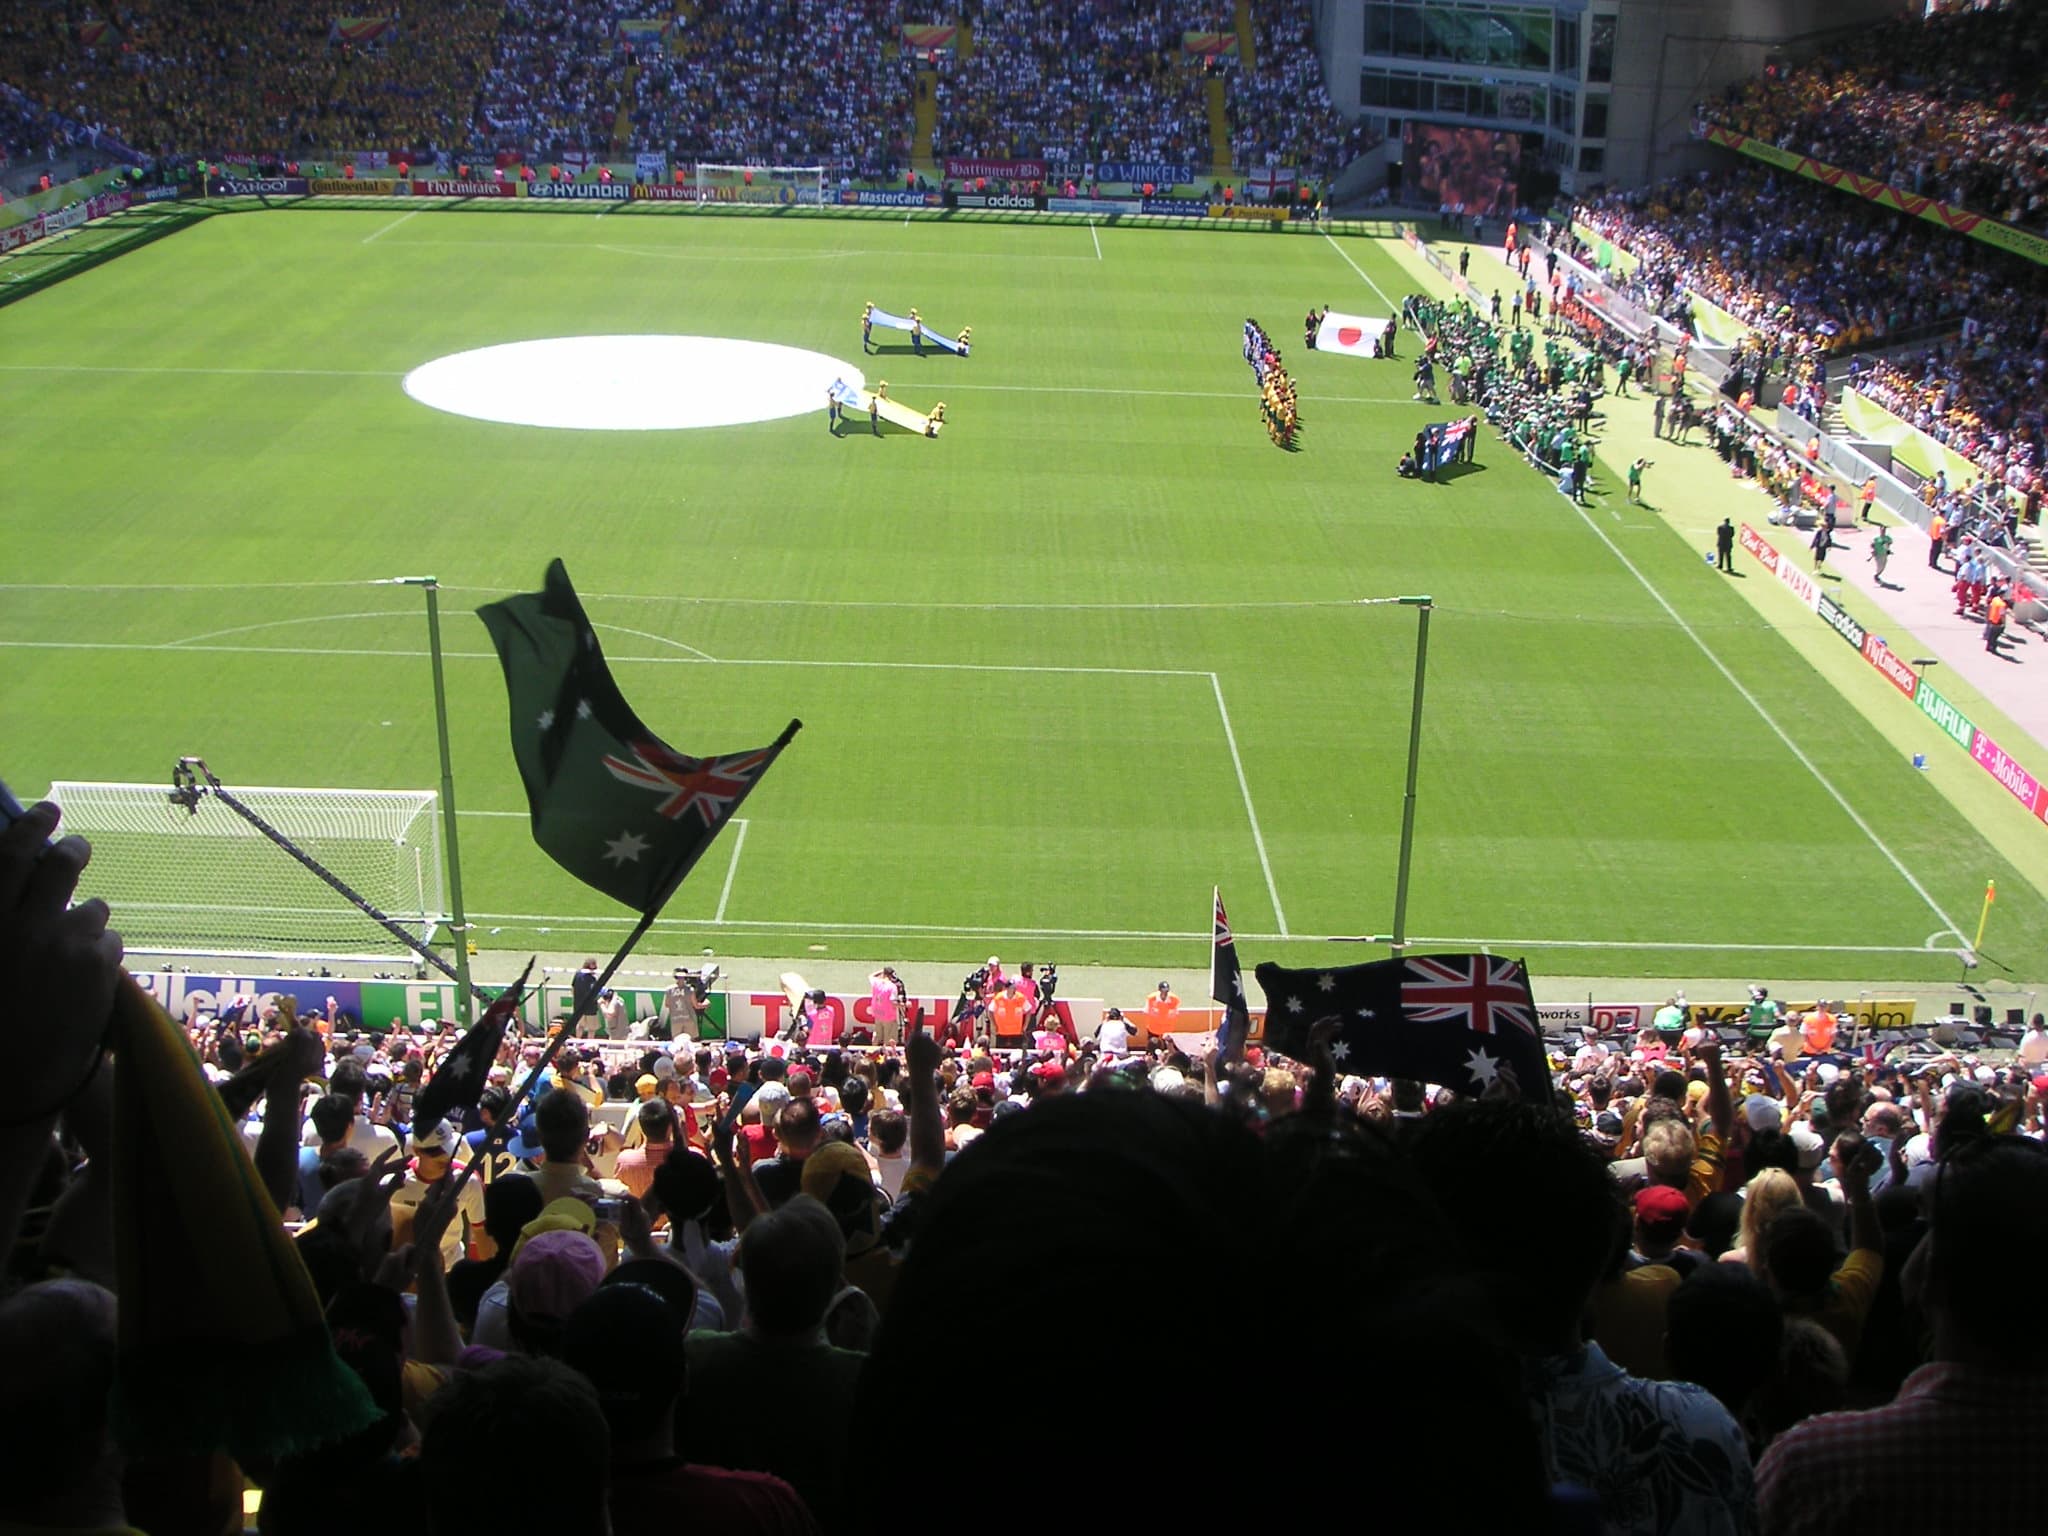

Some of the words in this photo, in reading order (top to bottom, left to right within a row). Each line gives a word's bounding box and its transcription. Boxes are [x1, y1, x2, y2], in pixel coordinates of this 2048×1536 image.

[1119, 165, 1191, 182] WINKELS
[228, 180, 288, 194] YAHOO!
[312, 180, 378, 193] Continental
[554, 183, 629, 199] HYUNDAI
[859, 192, 924, 206] MasterCard
[988, 195, 1035, 208] adidas
[1916, 682, 1971, 746] FUJIFILM
[480, 1151, 517, 1185] 12
